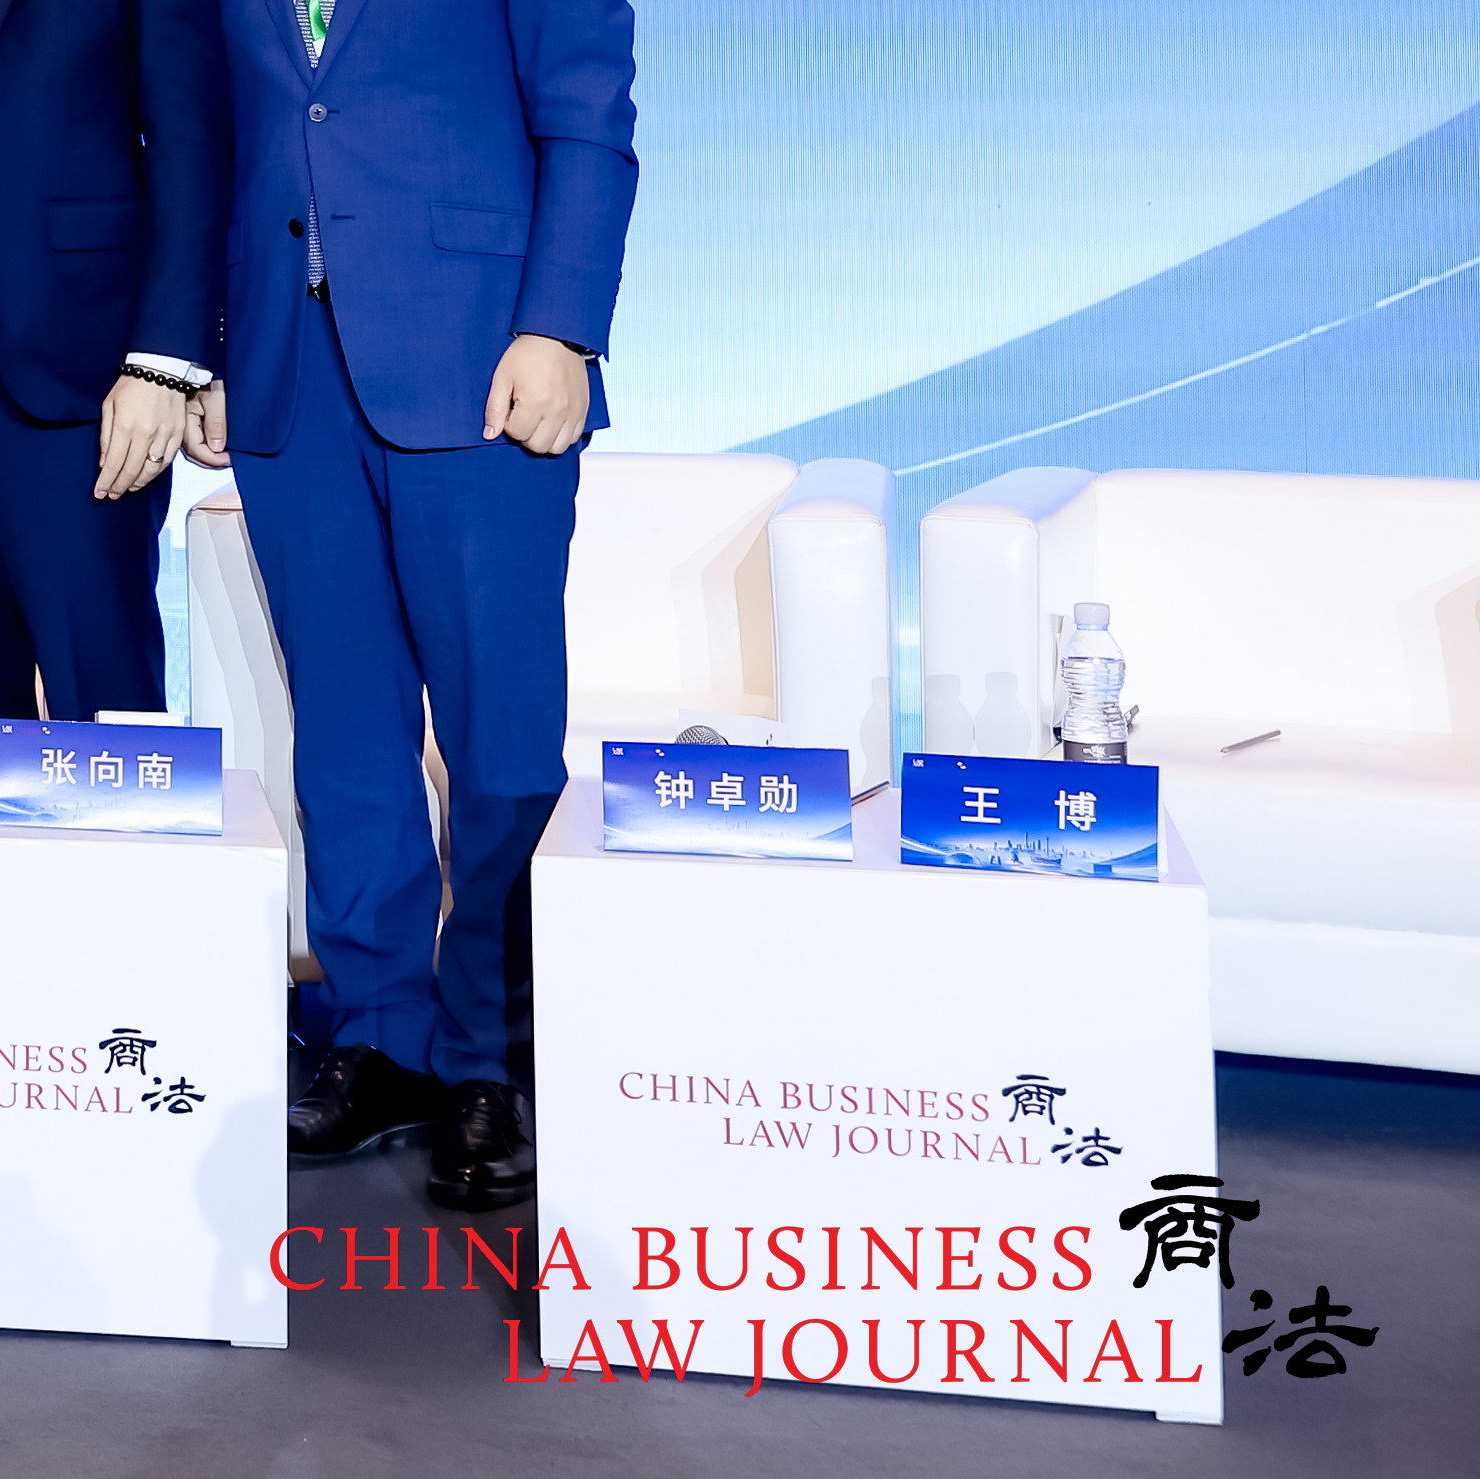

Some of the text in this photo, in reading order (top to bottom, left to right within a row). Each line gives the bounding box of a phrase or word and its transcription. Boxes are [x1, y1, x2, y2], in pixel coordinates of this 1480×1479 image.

[40, 747, 173, 790] 张向南
[653, 771, 797, 816] 钟卓勋
[620, 1072, 989, 1122] CHINA BUSINESS
[723, 1118, 1041, 1166] LAW JOURNAL
